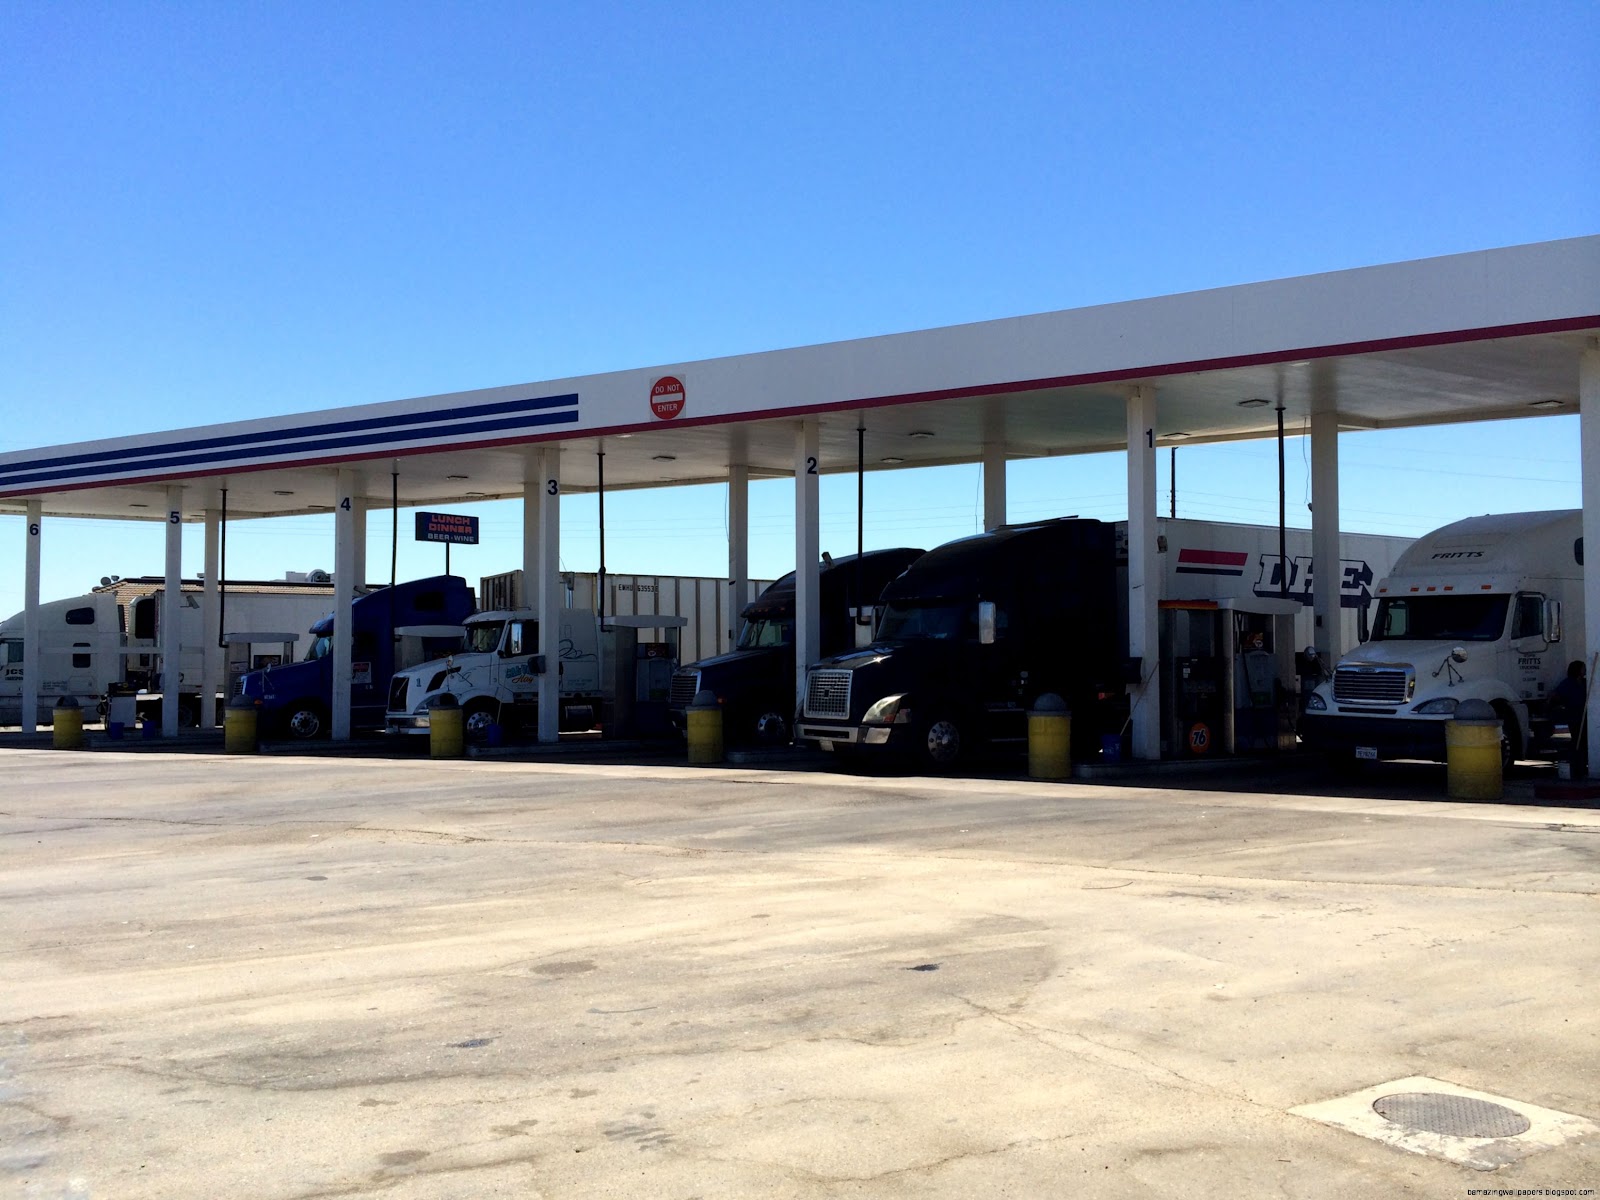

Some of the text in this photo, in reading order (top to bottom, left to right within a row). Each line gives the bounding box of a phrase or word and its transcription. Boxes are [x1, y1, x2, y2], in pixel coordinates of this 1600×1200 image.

[655, 384, 680, 394] DO NOT
[657, 404, 678, 412] ENTER
[1146, 428, 1153, 448] 1
[806, 457, 818, 475] 2
[547, 479, 558, 496] 3
[340, 497, 351, 511] 4
[169, 511, 180, 524] 5
[431, 515, 471, 525] LUNCH
[29, 523, 39, 536] 6
[428, 523, 473, 534] DINNER
[427, 533, 450, 541] BEER
[1431, 552, 1485, 560] FRITTS
[1193, 729, 1206, 745] 76
